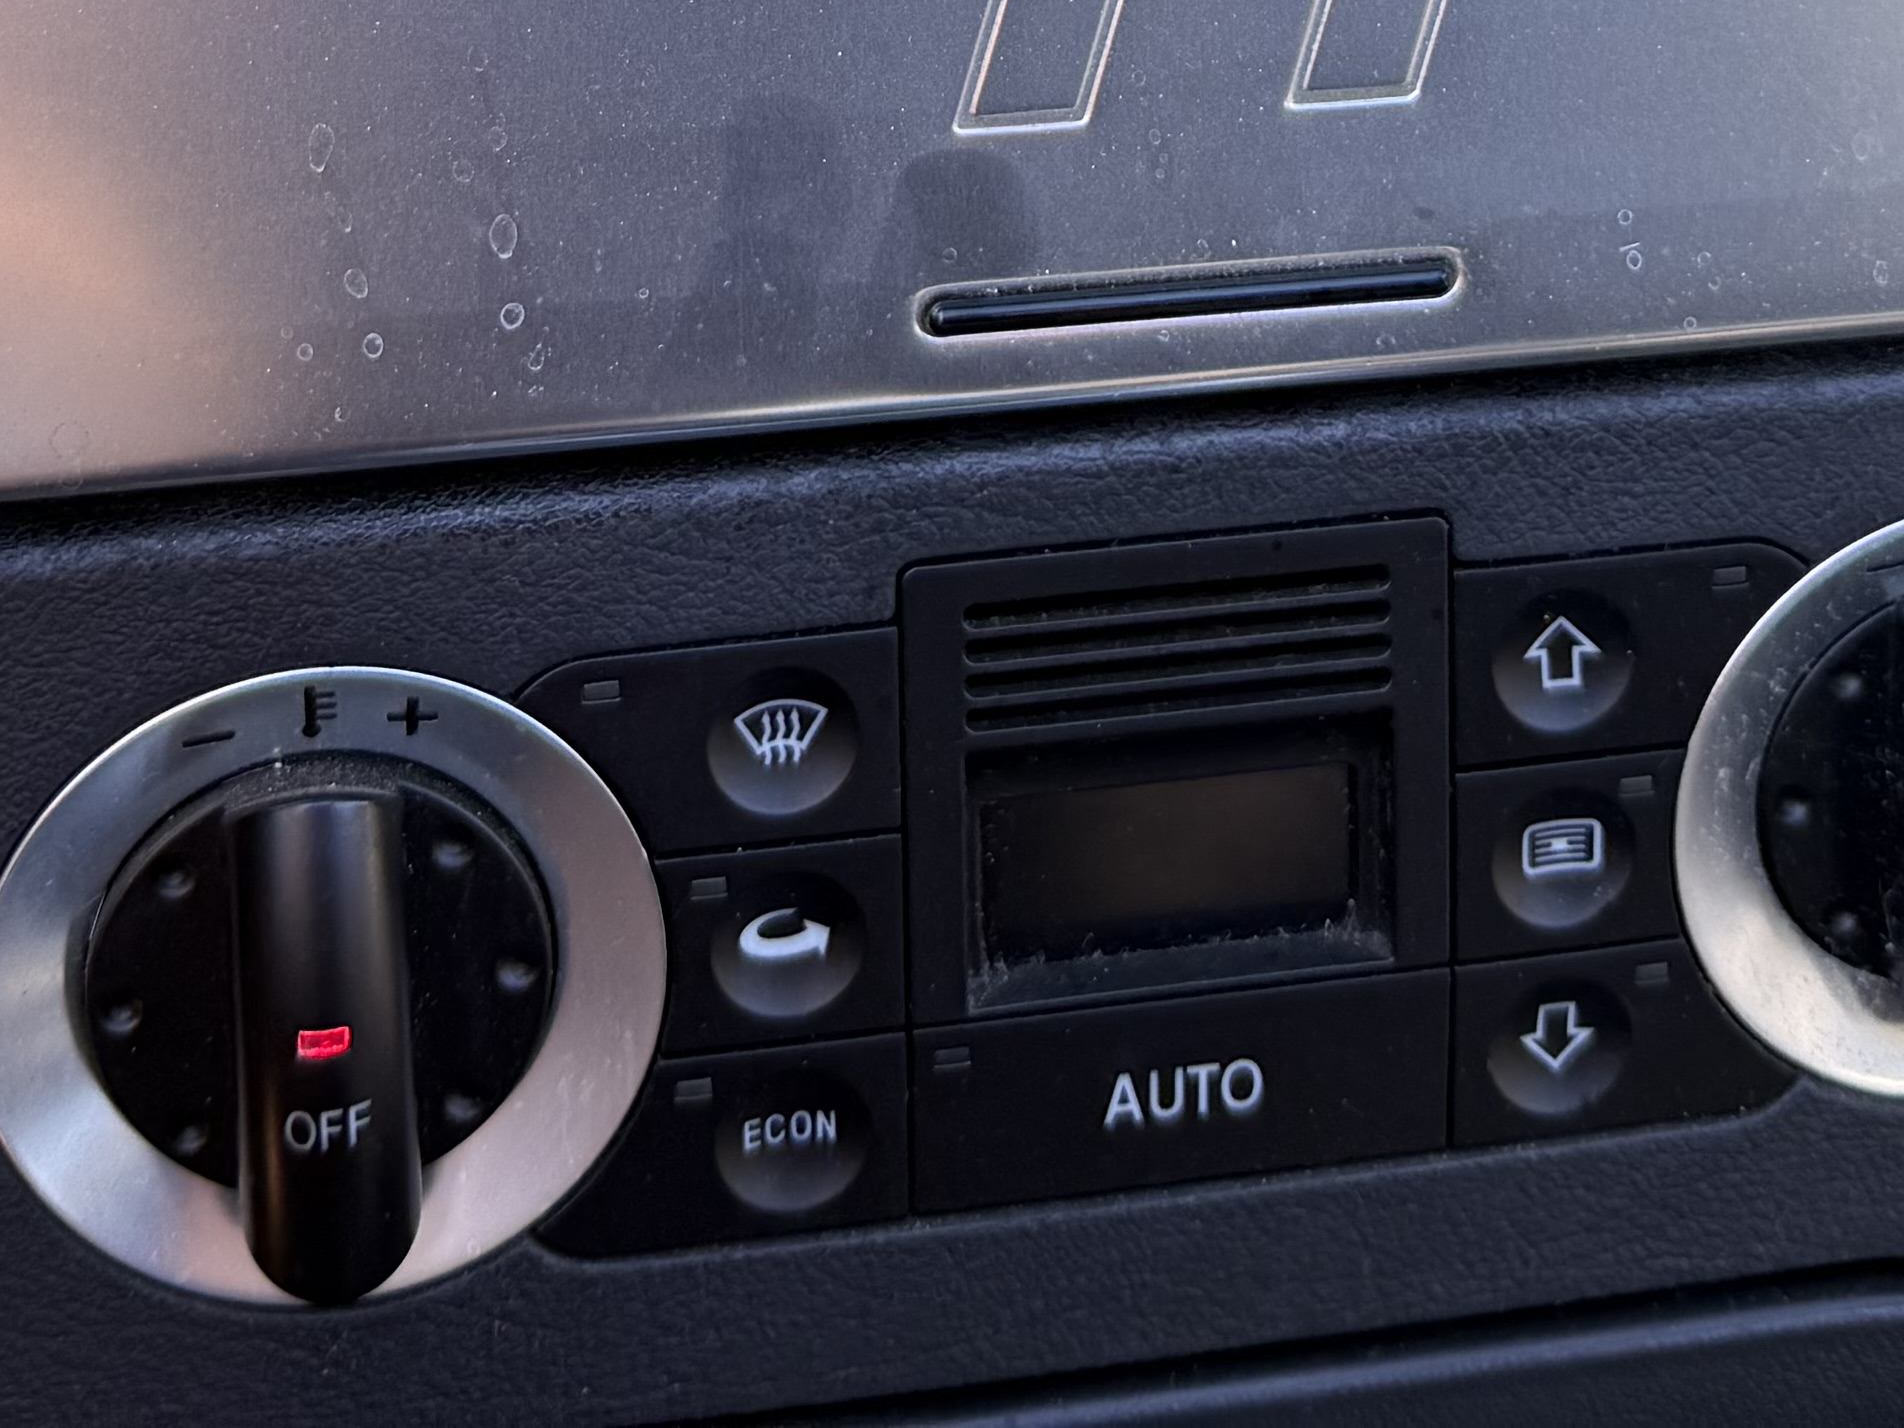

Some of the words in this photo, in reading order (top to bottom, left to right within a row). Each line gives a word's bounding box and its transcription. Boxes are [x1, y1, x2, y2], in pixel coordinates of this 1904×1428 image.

[1103, 1057, 1263, 1128] AUTO
[285, 1098, 372, 1152] OFF
[743, 1109, 836, 1151] ECON
